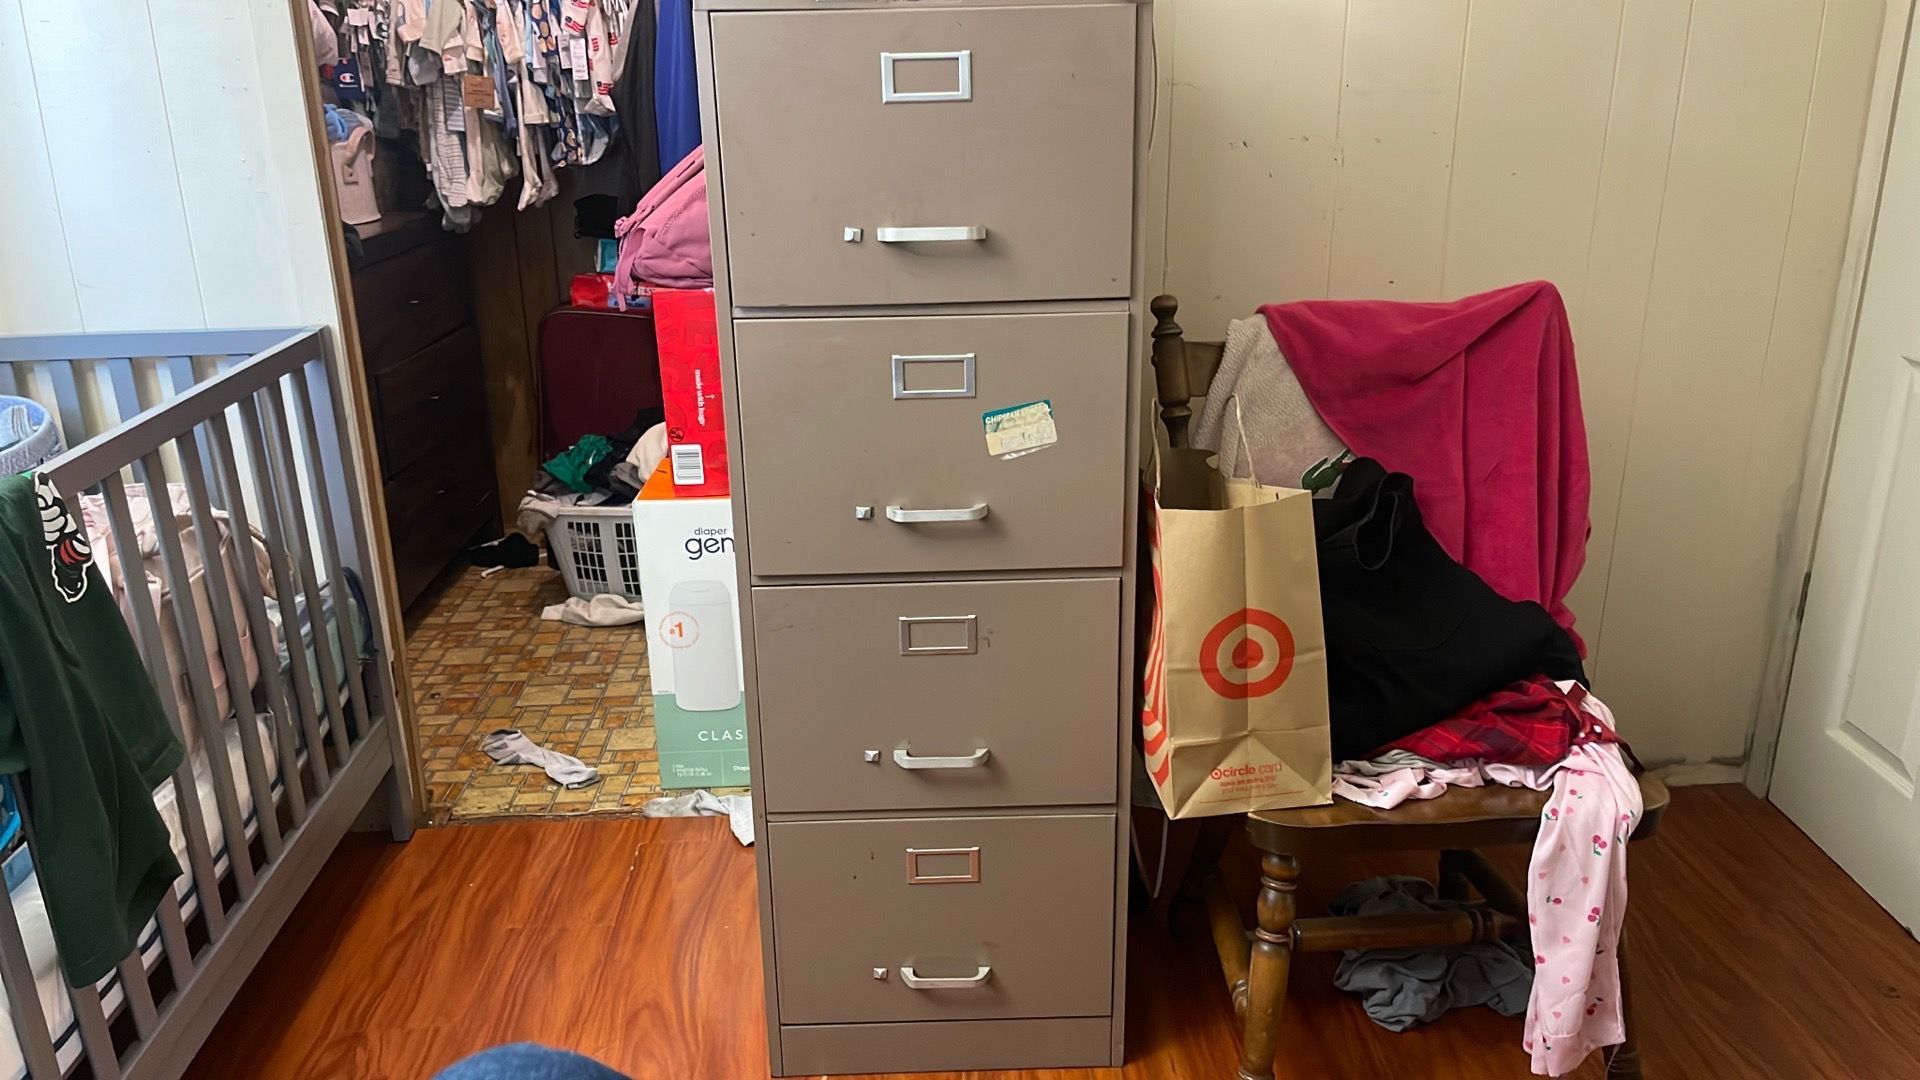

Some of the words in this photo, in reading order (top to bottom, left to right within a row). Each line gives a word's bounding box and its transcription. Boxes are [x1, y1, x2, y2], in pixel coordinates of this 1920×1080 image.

[697, 390, 705, 407] with
[694, 527, 727, 537] diaper
[697, 729, 743, 741] CLAS
[1222, 765, 1256, 777] circle
[1258, 762, 1282, 774] card
